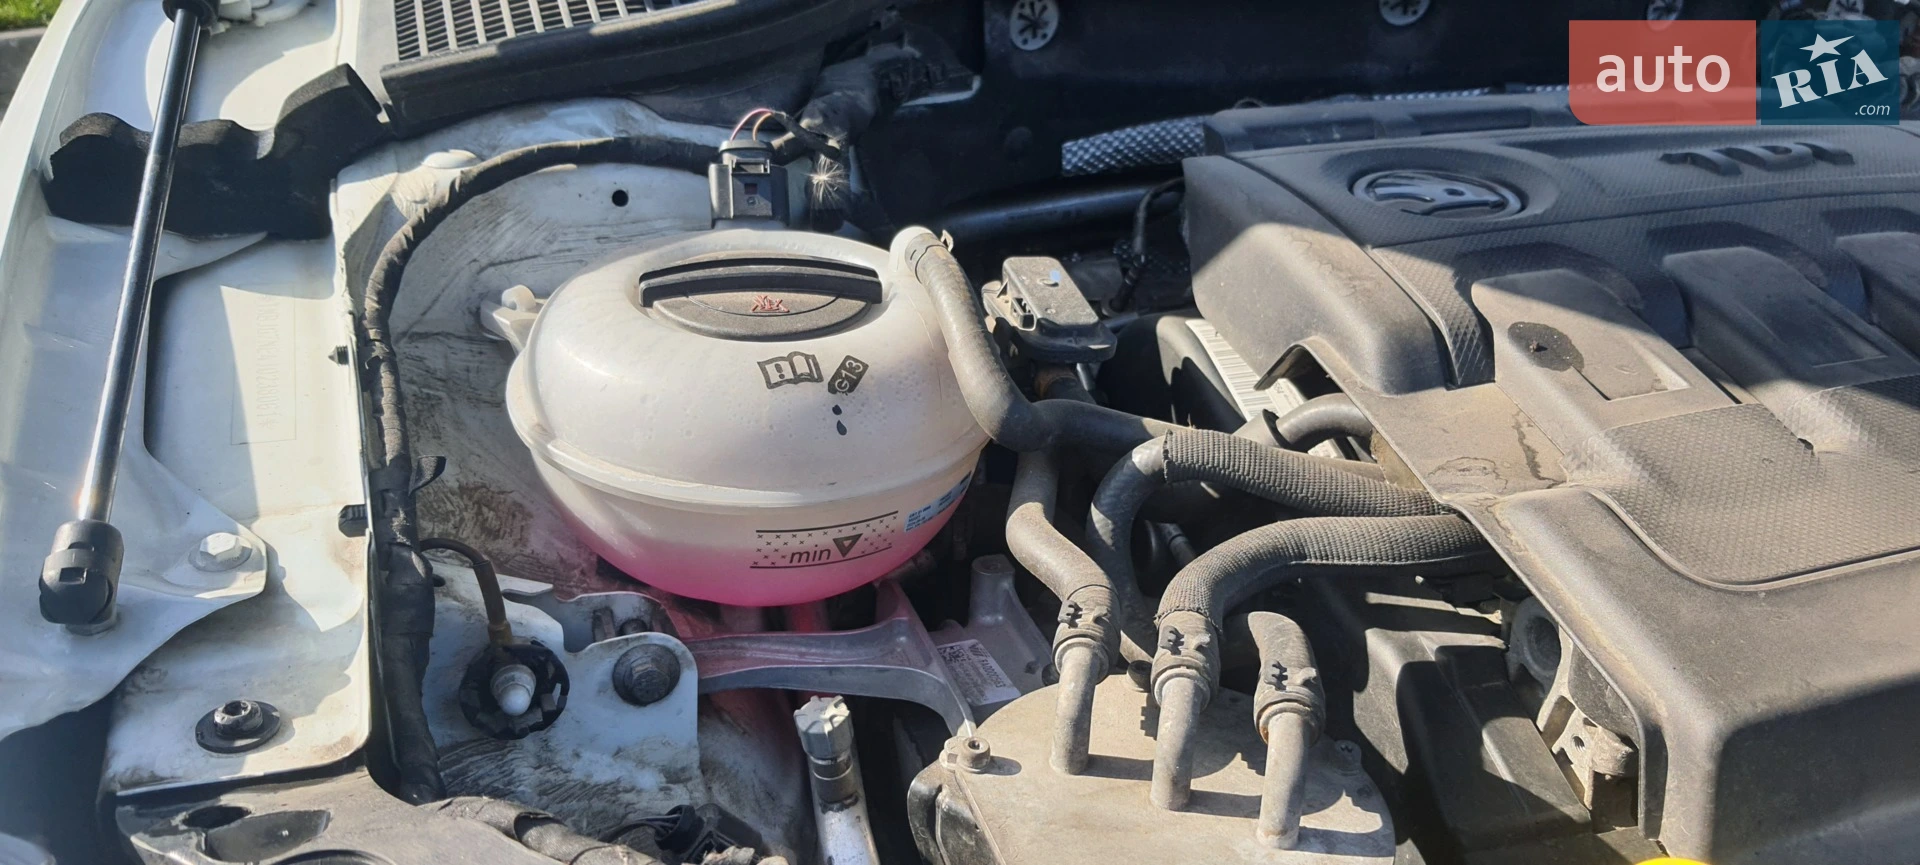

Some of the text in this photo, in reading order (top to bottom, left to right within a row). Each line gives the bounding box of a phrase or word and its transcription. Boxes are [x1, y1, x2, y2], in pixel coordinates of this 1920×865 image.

[1659, 142, 1856, 177] TDI
[834, 359, 864, 392] G13
[789, 544, 831, 564] min
